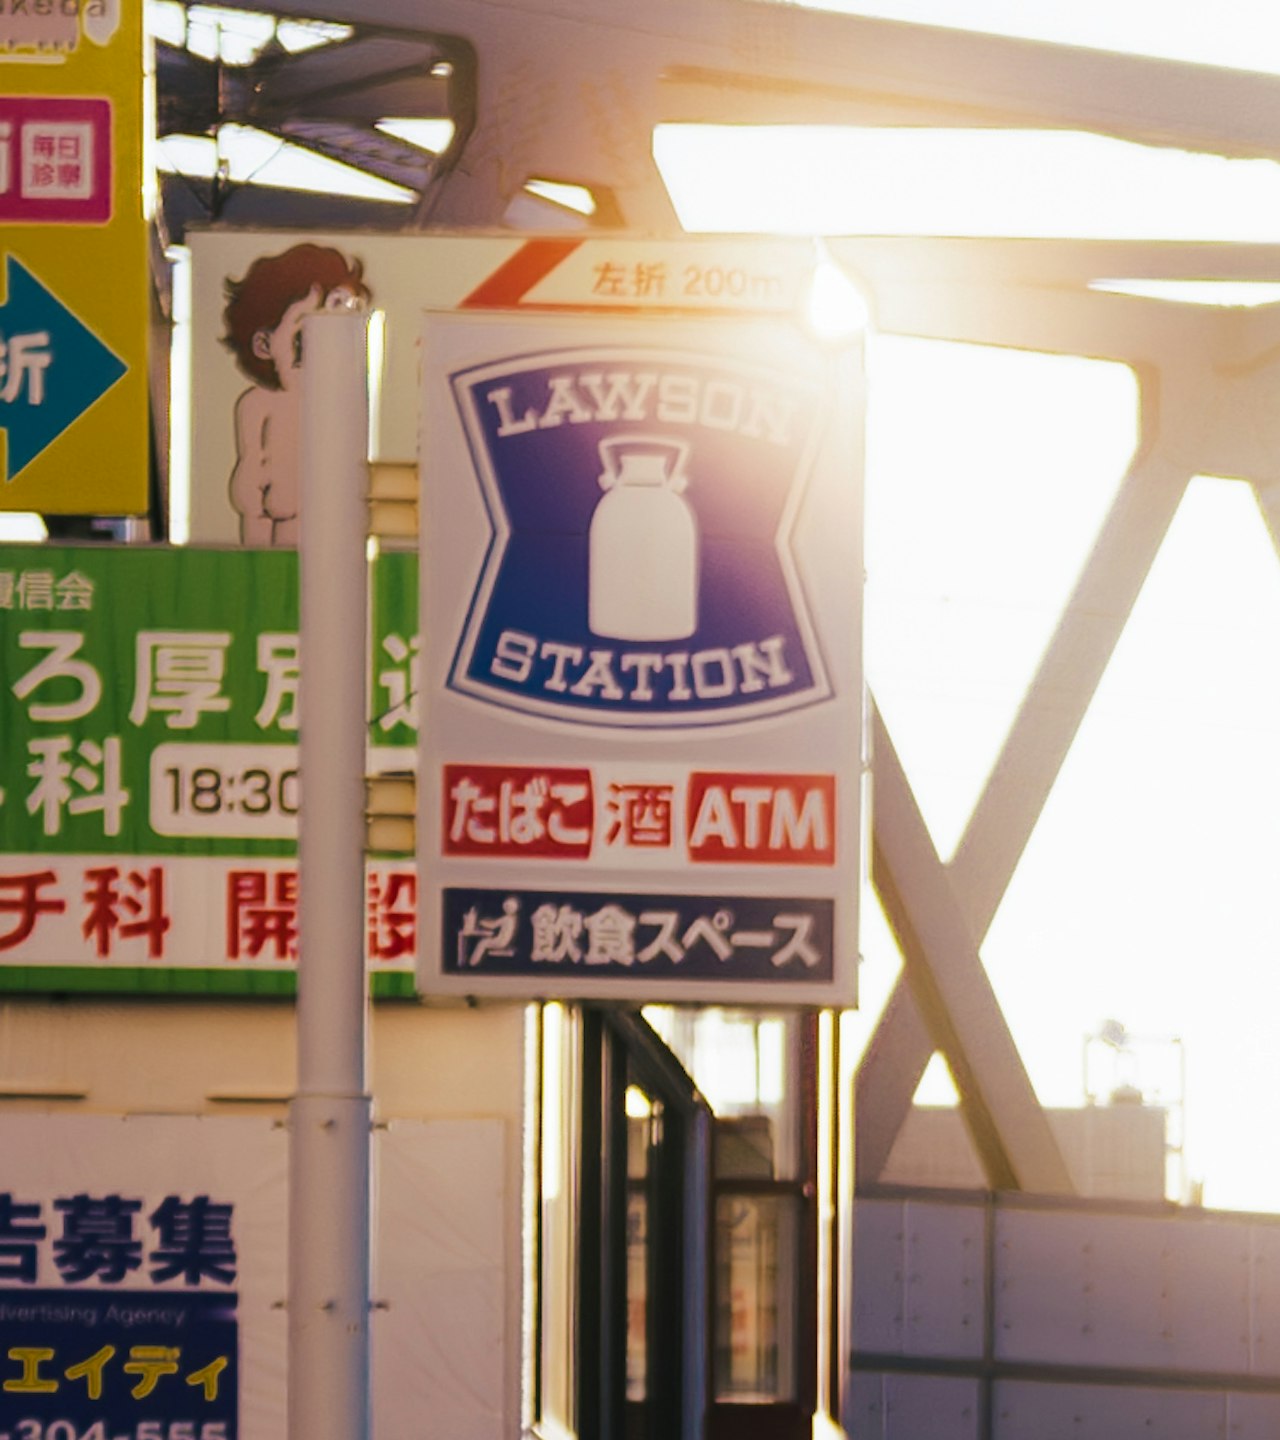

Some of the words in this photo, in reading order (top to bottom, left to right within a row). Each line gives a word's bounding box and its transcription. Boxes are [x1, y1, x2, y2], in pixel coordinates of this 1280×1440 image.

[592, 261, 666, 296] 左折
[683, 264, 783, 297] 200m
[486, 373, 803, 446] LAWSON
[490, 629, 795, 701] STATION
[26, 734, 129, 836] 科
[449, 776, 590, 845] たばこ
[604, 783, 674, 848] 酒
[689, 785, 830, 851] ATM
[531, 903, 823, 968] 飲食スペース
[104, 1304, 186, 1327] Agency
[3, 1344, 228, 1401] エイディ
